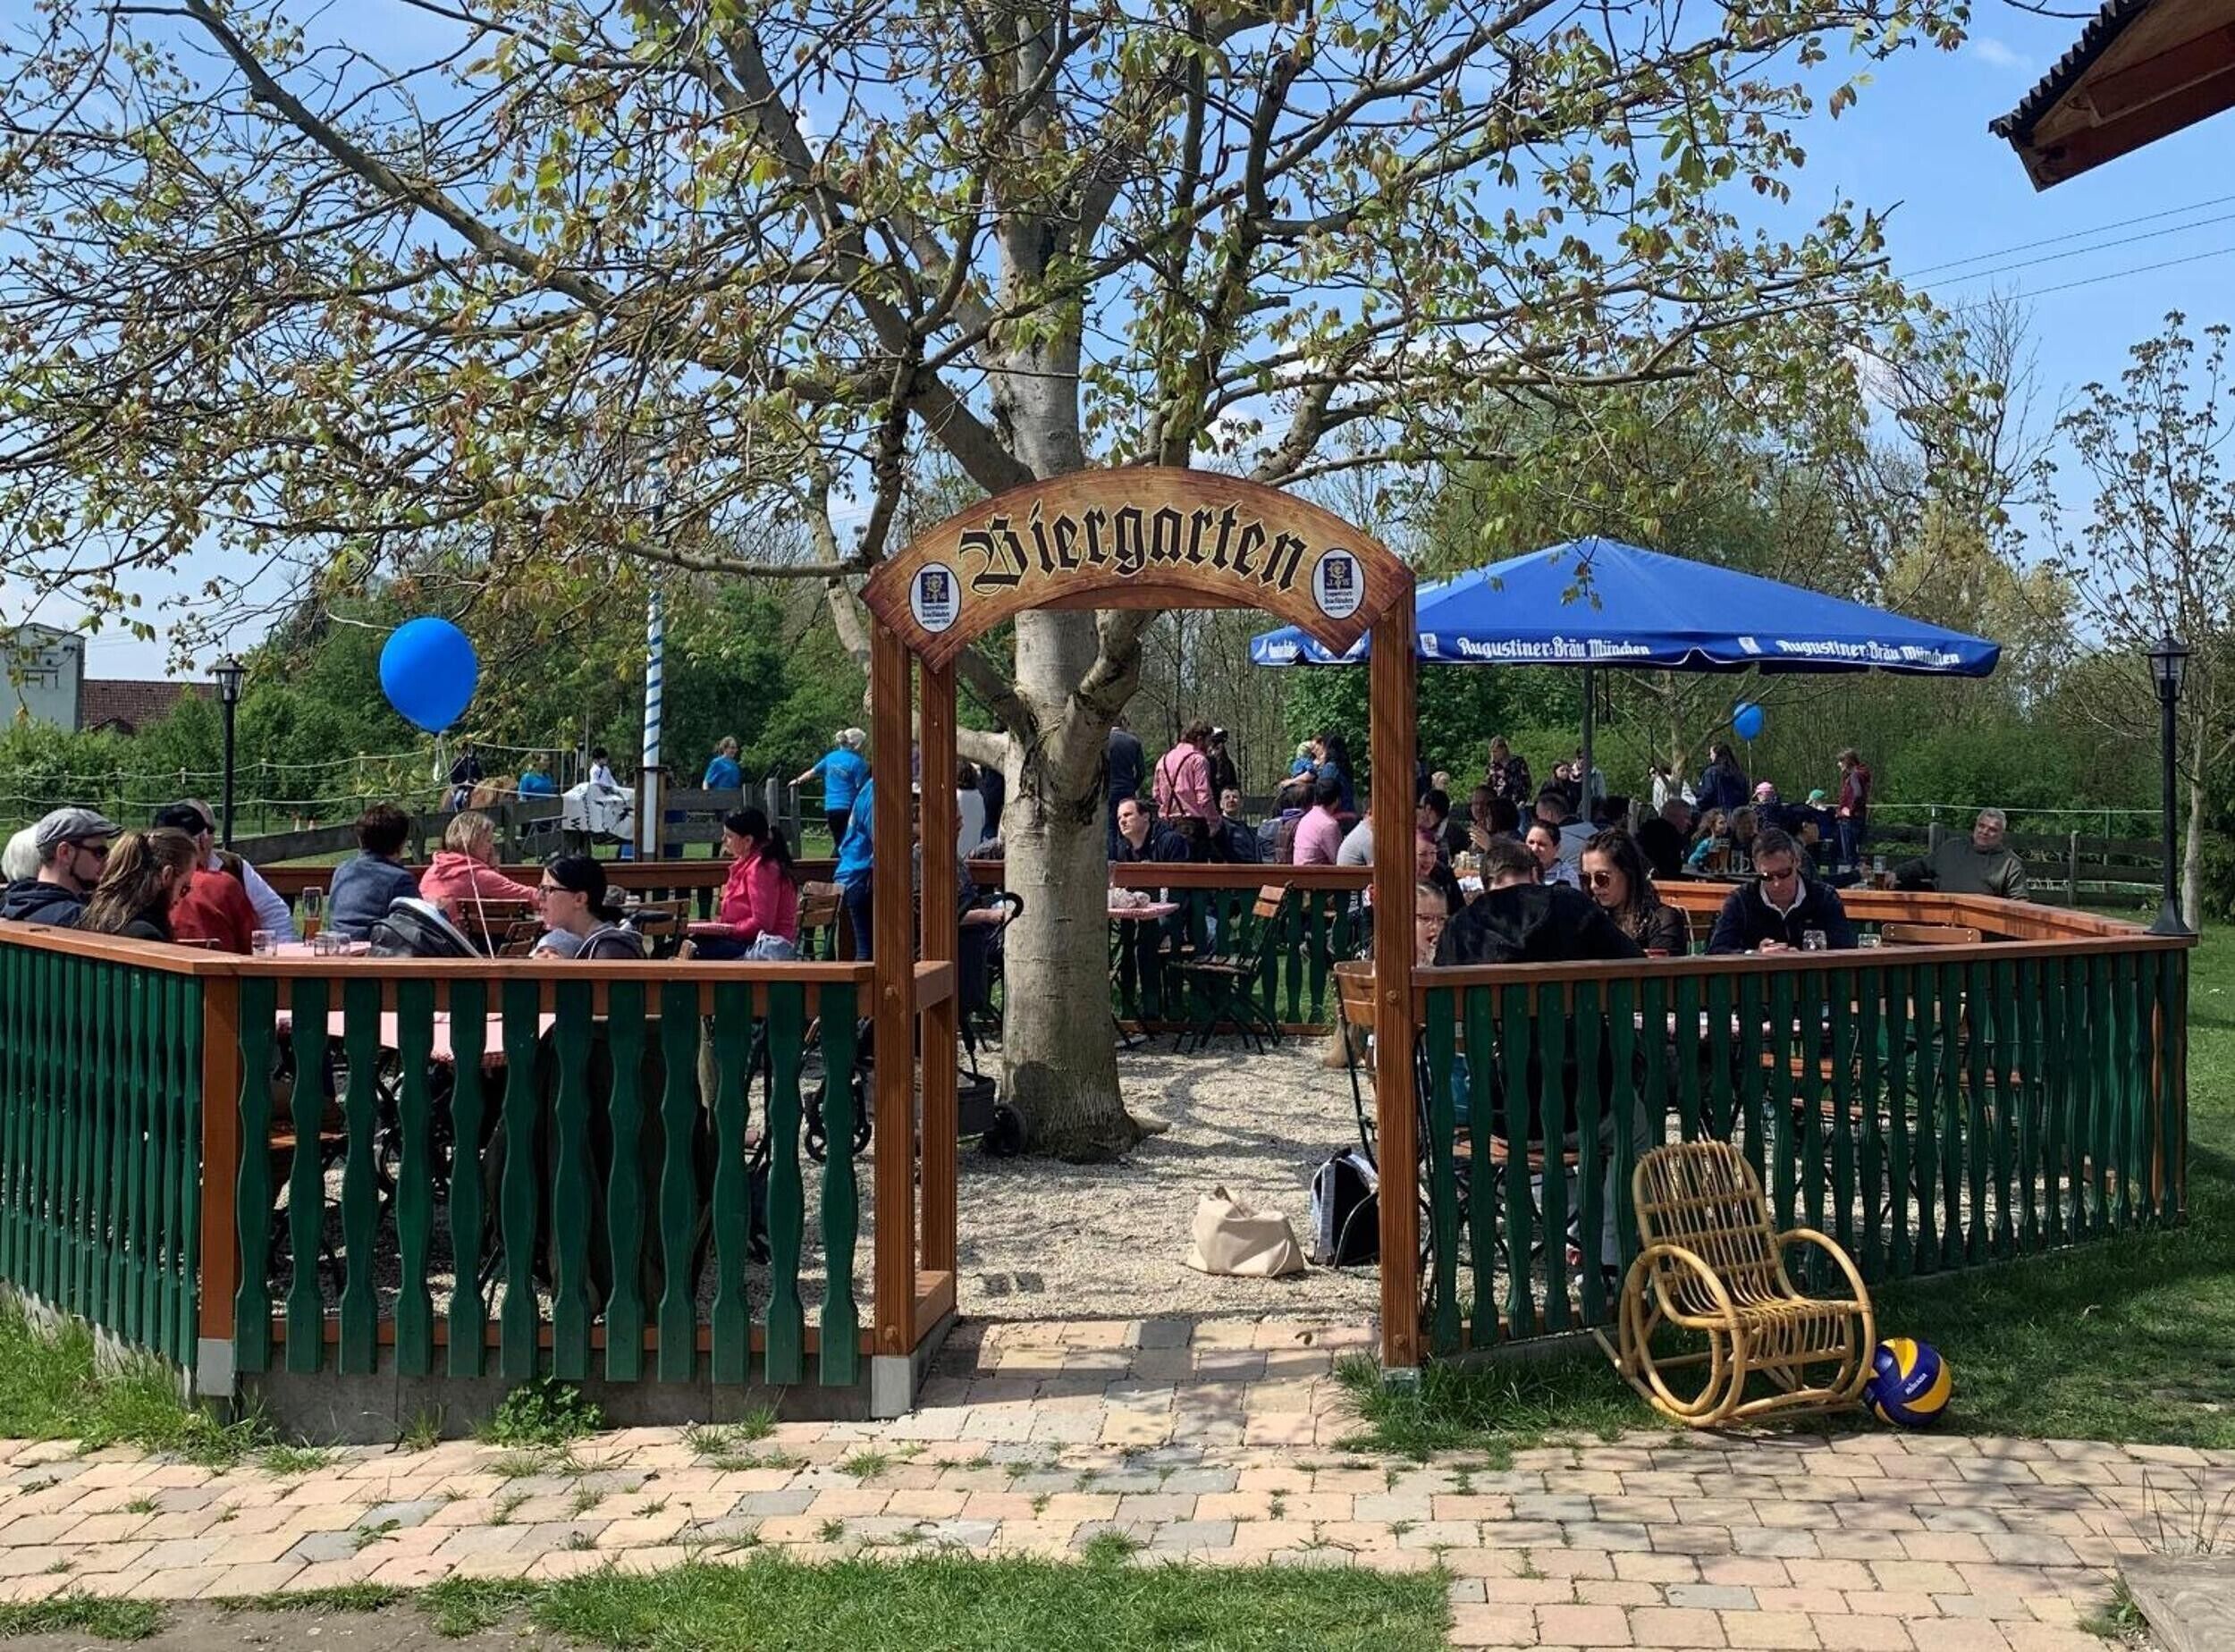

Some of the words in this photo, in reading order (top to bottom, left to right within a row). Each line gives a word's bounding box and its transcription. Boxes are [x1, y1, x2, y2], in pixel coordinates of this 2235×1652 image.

[959, 500, 1308, 594] Biergarten
[1587, 638, 1650, 659] München
[1901, 645, 1960, 666] München
